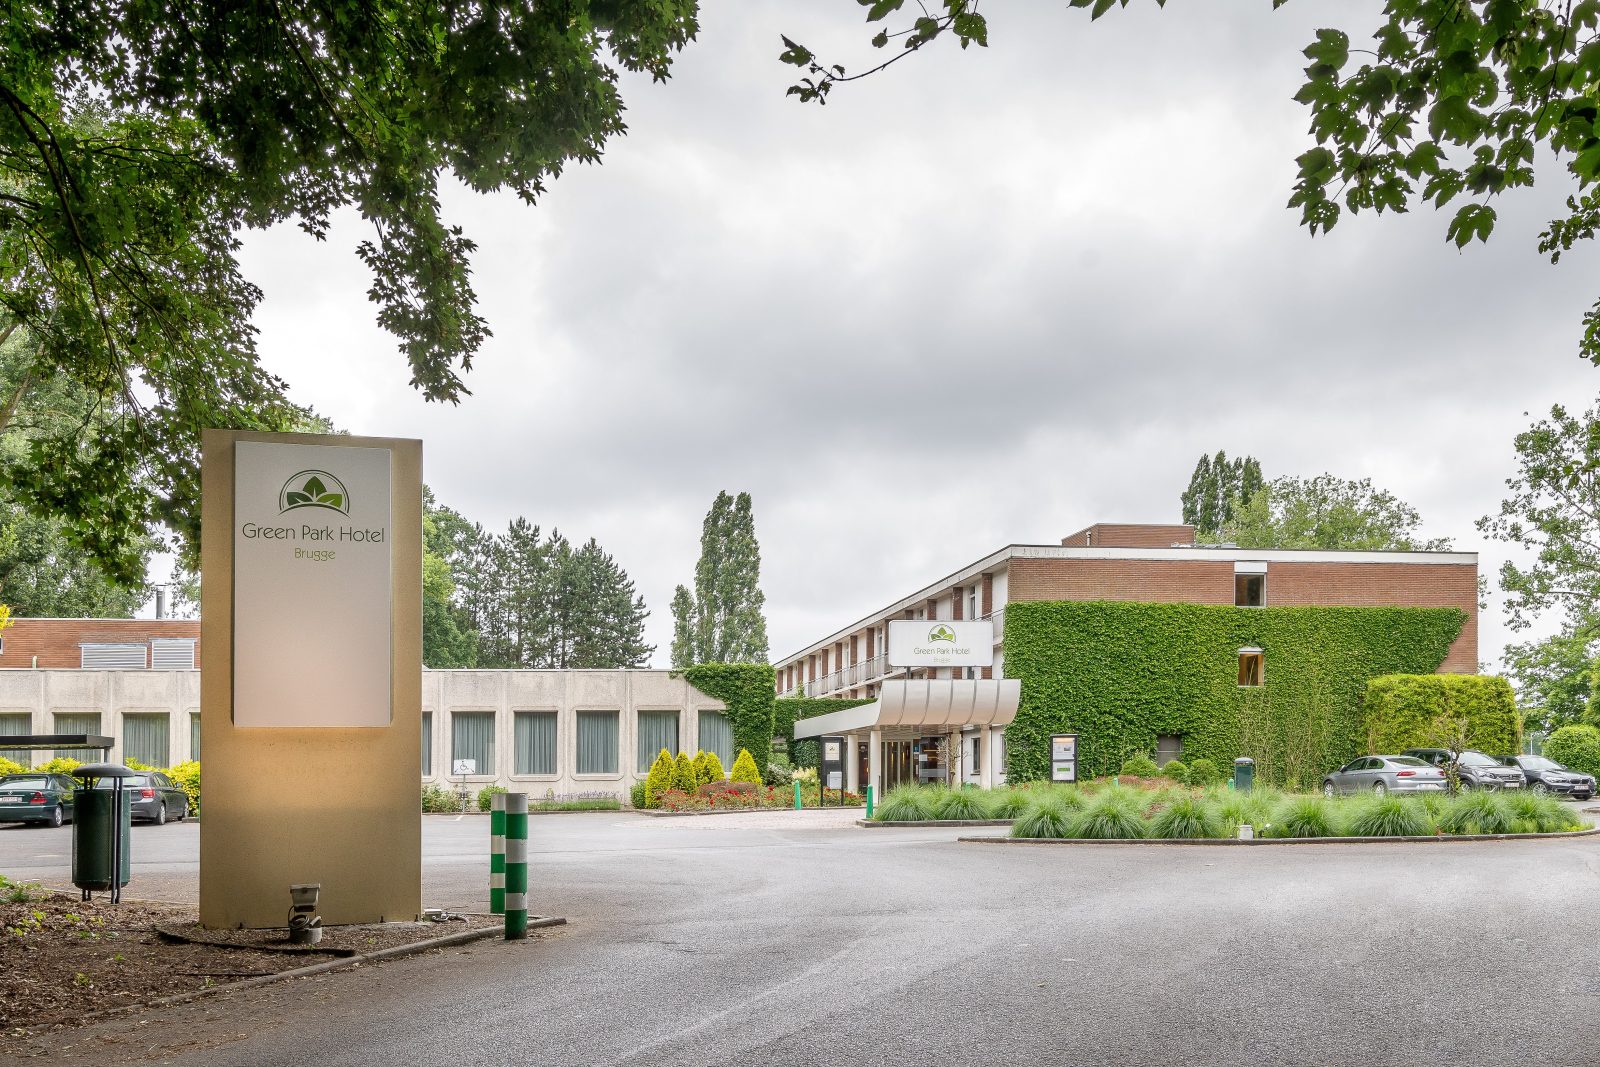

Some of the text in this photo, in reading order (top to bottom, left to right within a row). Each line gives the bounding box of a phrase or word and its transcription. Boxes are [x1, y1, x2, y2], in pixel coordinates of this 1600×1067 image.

[242, 522, 385, 543] Green Park Hotel
[294, 547, 336, 562] Brugge
[913, 647, 970, 655] Green Park Hotel
